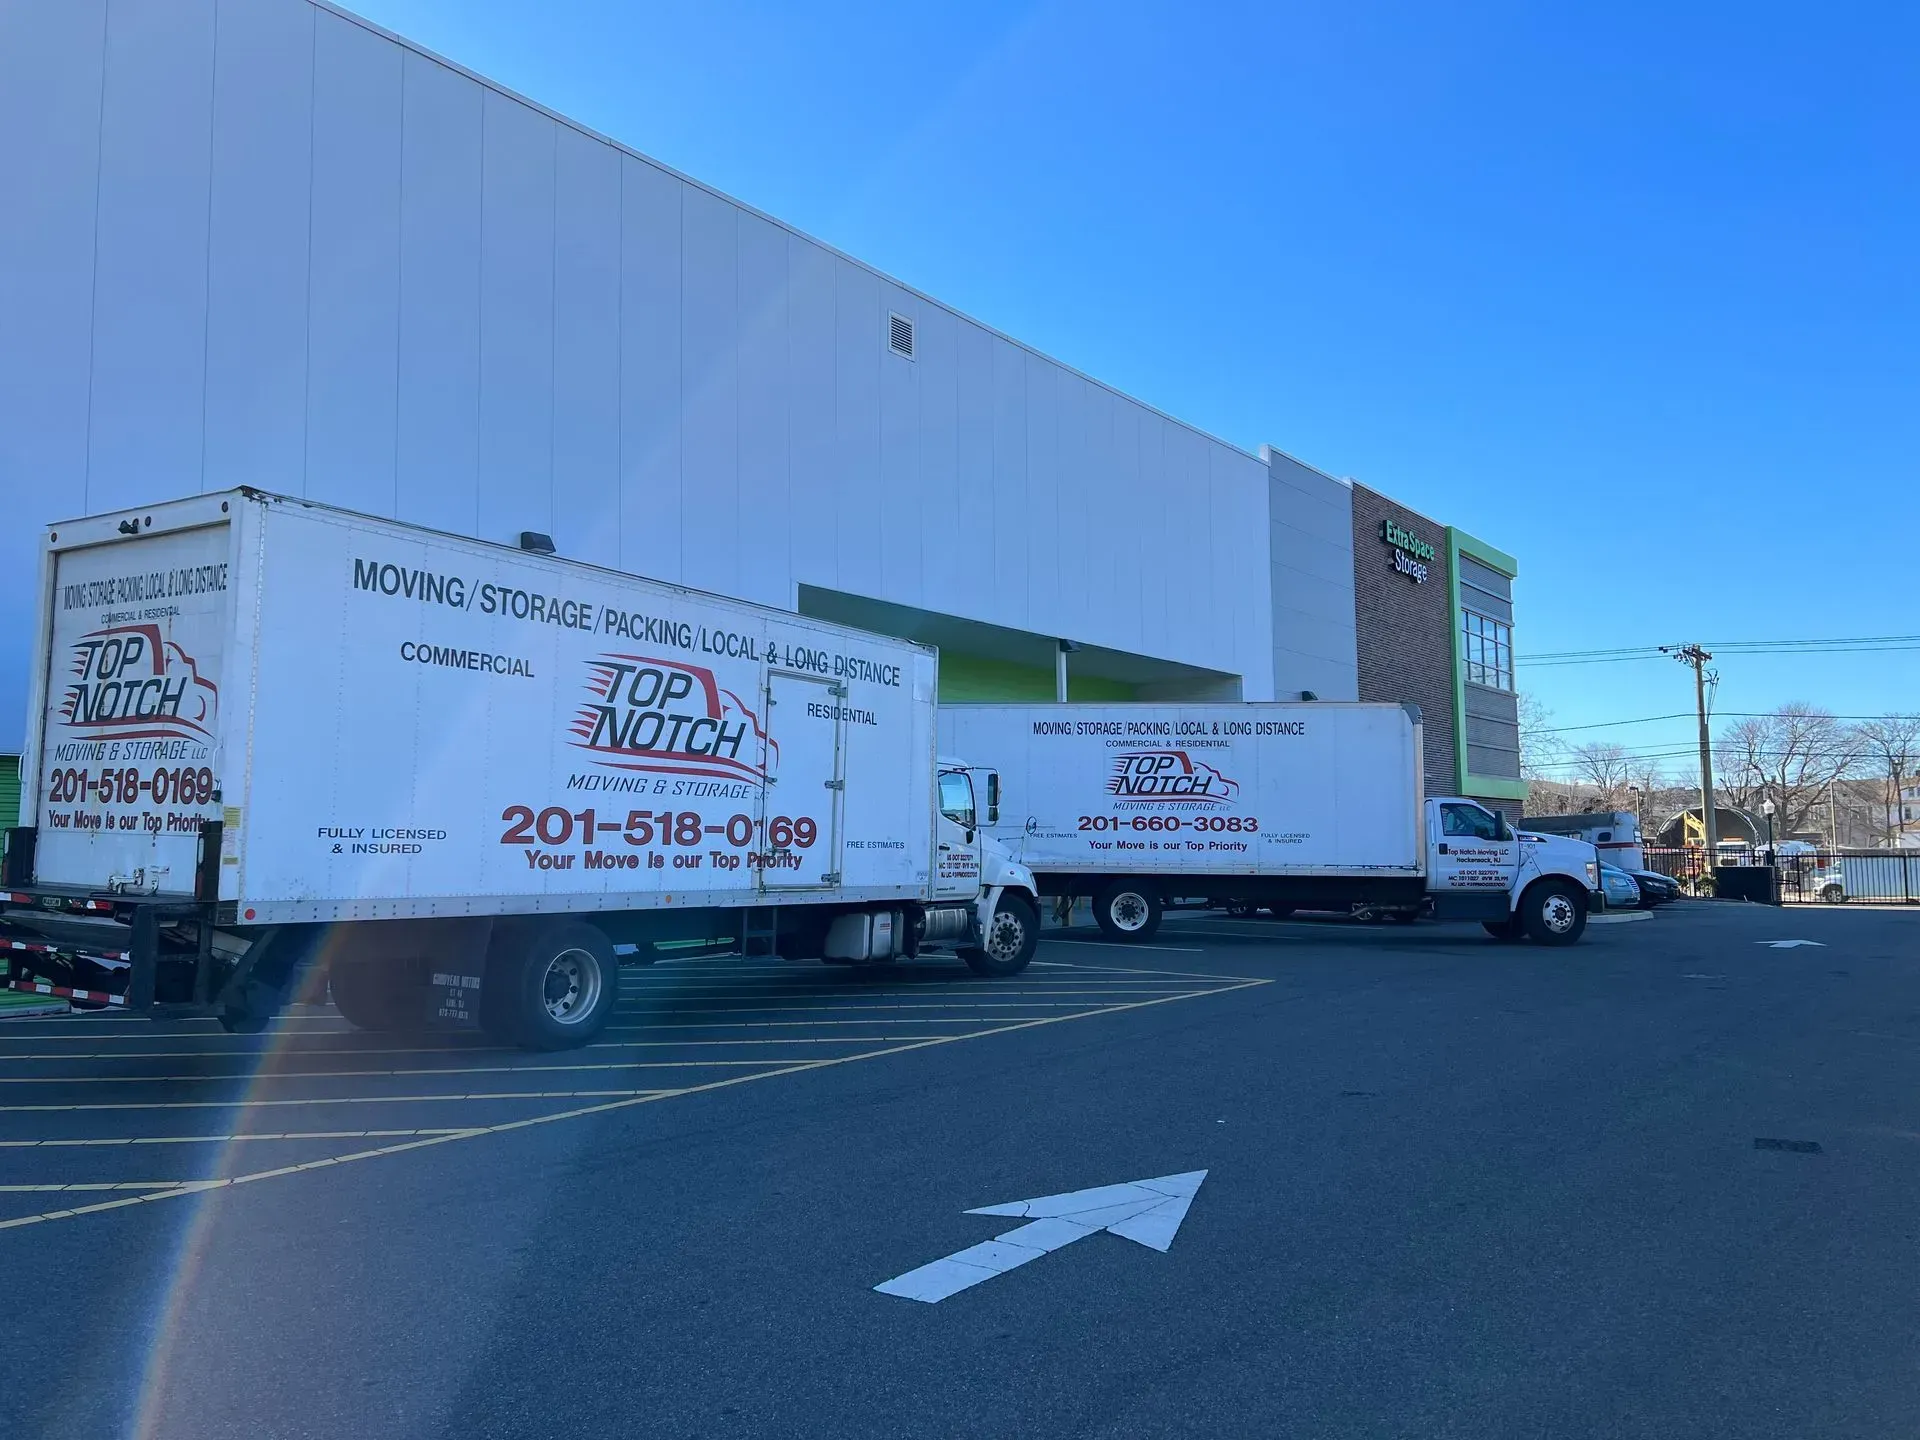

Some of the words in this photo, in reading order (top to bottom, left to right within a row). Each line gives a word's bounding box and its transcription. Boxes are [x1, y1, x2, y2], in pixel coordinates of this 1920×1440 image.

[1395, 548, 1428, 584] Storage
[175, 567, 194, 596] LONG
[195, 563, 228, 593] DISTANCE
[101, 610, 136, 625] COMMERCIAL
[144, 605, 181, 619] RESIDENTIAL
[70, 636, 144, 681] TOP
[400, 641, 535, 678] COMMERCIAL
[766, 641, 778, 665] &
[785, 644, 829, 674] LONG
[834, 655, 900, 688] DISTANCE
[582, 660, 693, 710] TOP
[66, 676, 188, 723] NOTCH
[807, 702, 878, 726] RESIDENTIAL
[580, 703, 747, 759] NOTCH
[1212, 722, 1219, 735] &
[1223, 722, 1252, 735] LONG
[1255, 722, 1305, 735] DISTANCE
[55, 742, 106, 762] MOVING
[108, 741, 121, 761] &
[123, 740, 191, 761] STORAGE
[191, 747, 209, 760] LLC
[1105, 740, 1162, 748] COMMERCIAL
[1175, 740, 1230, 748] RESIDENTIAL
[1111, 756, 1175, 775] TOP
[49, 767, 213, 805] 201-518-0169
[566, 773, 648, 795] MOVING
[653, 779, 666, 795] &
[672, 780, 754, 799] STORAGE
[1109, 775, 1212, 795] NOTCH
[1112, 802, 1155, 811] MOVING
[1157, 802, 1165, 811] &
[1167, 802, 1217, 811] STORAGE
[49, 810, 71, 828] Your
[74, 810, 101, 829] Move
[105, 811, 115, 830] is
[119, 814, 139, 831] our
[143, 812, 163, 833] Top
[500, 805, 817, 849] 201-518-069
[1077, 816, 1259, 833] 201-660-3083
[318, 827, 366, 839] FULLY
[372, 828, 447, 840] LICENSED
[846, 840, 865, 849] FREE
[867, 840, 905, 849] ESTIMATES
[331, 843, 343, 854] &
[352, 843, 423, 854] INSURED
[1088, 840, 1113, 850] Your
[1117, 841, 1145, 850] Move
[1149, 841, 1159, 850] is
[1163, 842, 1181, 850] our
[1185, 841, 1204, 852] Top
[1208, 841, 1248, 852] Priority
[1459, 848, 1477, 856] Notch
[1477, 848, 1498, 857] Moving
[1499, 848, 1510, 856] LLC
[524, 849, 576, 870] Your
[584, 850, 639, 870] Move
[672, 853, 703, 869] our
[712, 850, 740, 872] Top
